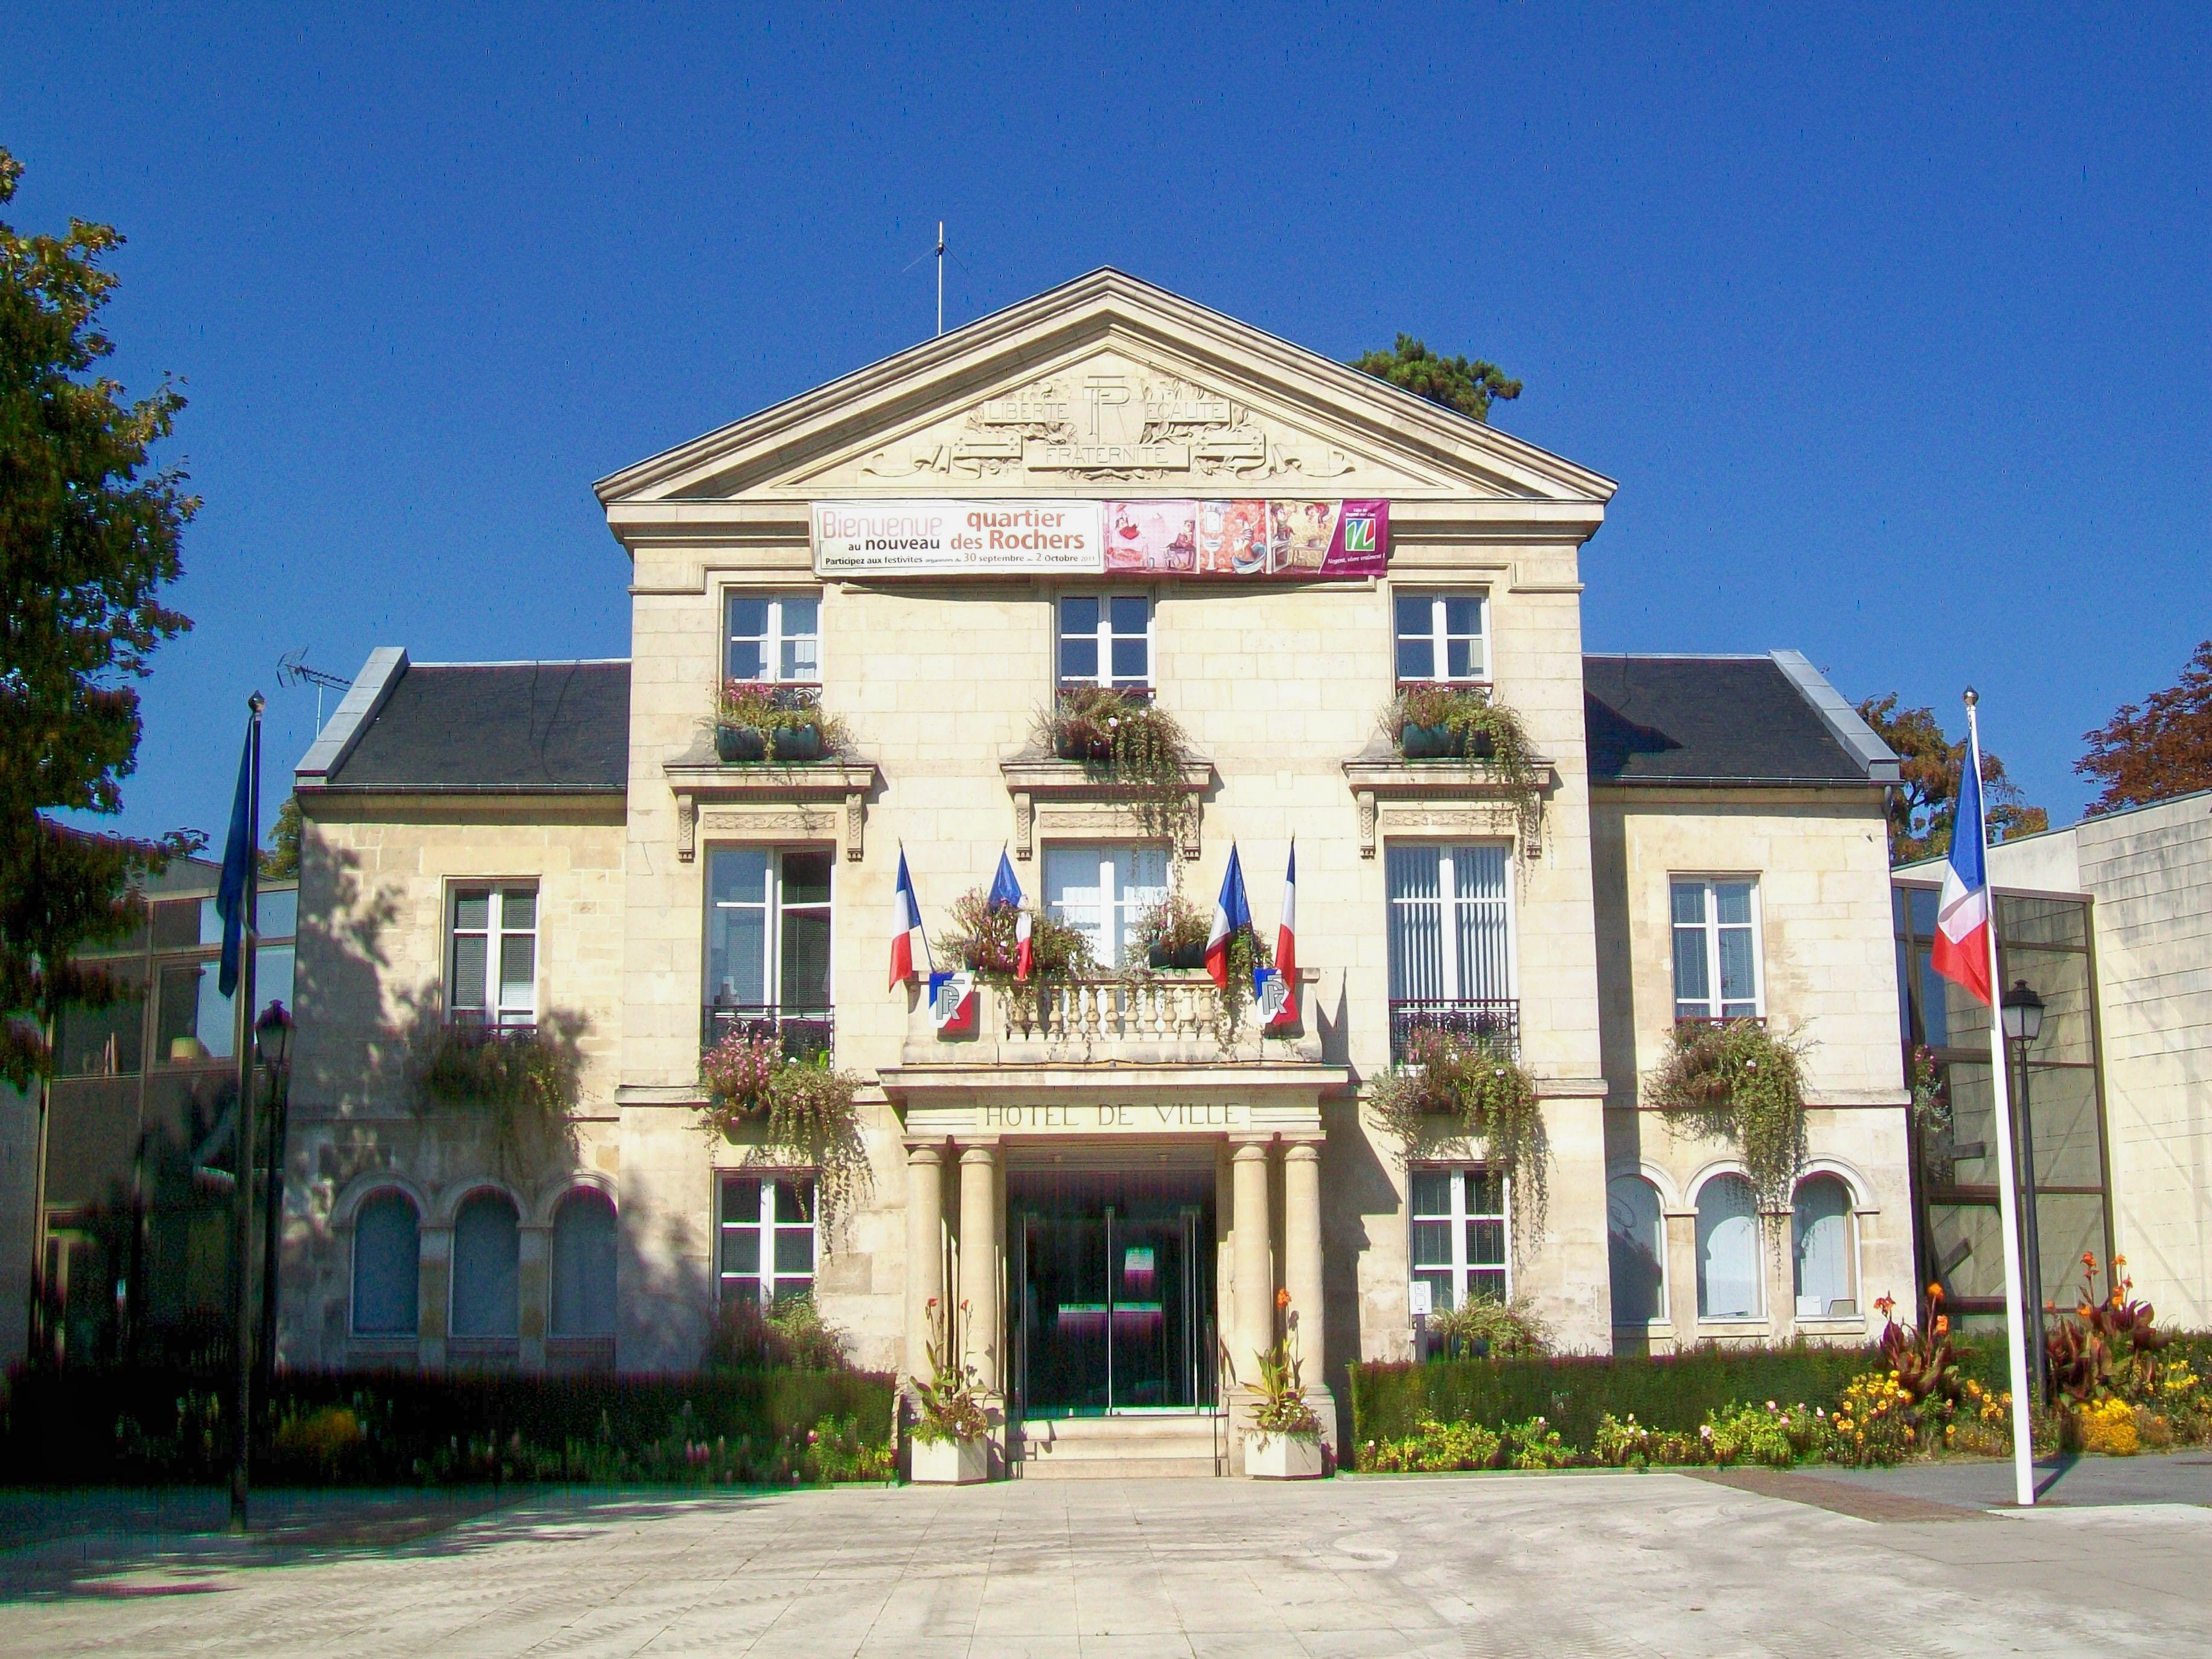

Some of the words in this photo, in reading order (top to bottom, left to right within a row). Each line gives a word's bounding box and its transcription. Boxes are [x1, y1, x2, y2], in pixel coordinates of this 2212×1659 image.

[988, 403, 1070, 420] LIBERTE
[1046, 447, 1168, 464] FRATERNITE
[823, 511, 942, 539] Bienvenue
[967, 509, 1066, 532] quartier
[865, 539, 940, 551] nouveau
[950, 533, 983, 549] des
[989, 529, 1085, 549] Rochers
[825, 557, 865, 566] Participez
[964, 552, 977, 562] 30
[979, 555, 1024, 563] septembre
[1035, 552, 1042, 561] 2
[986, 1104, 1079, 1127] HOTEL
[1098, 1104, 1134, 1125] DE
[1153, 1103, 1241, 1124] VILLE
